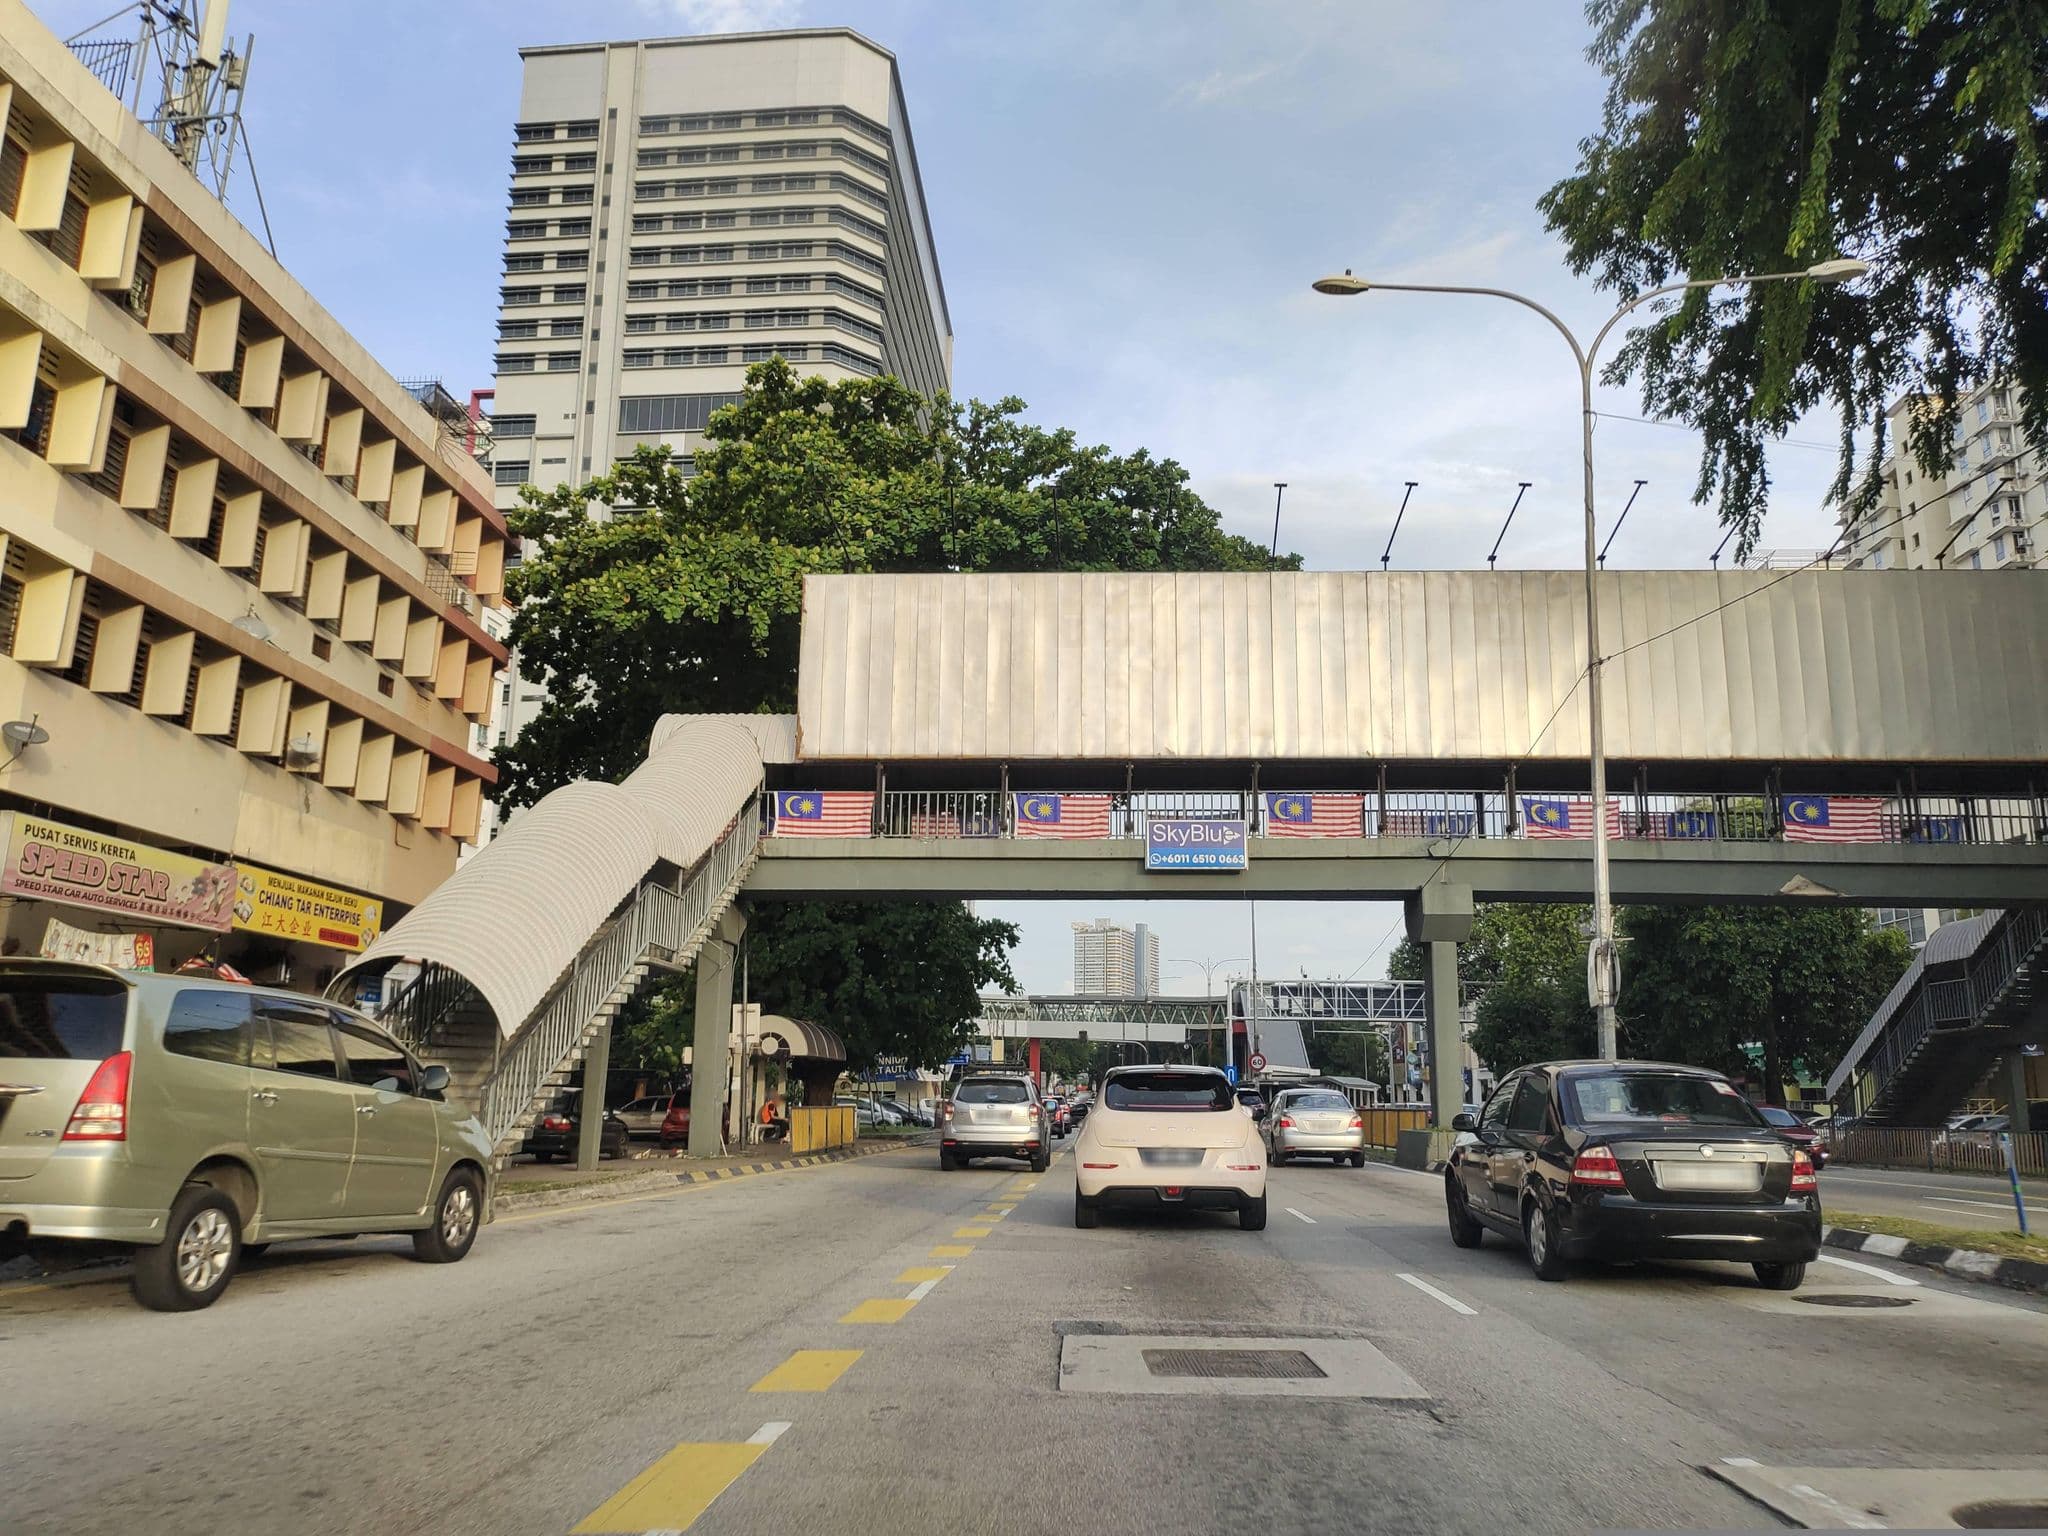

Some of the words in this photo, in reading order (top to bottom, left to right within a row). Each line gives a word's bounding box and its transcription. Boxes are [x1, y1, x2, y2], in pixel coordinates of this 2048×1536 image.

[24, 824, 60, 843] PUSAT
[63, 833, 98, 852] SERVIS
[100, 842, 136, 861] KERETA
[20, 841, 107, 888] SPEED
[107, 861, 170, 902] STAR
[1161, 854, 1190, 864] +6011
[1192, 854, 1216, 864] 6510
[1218, 854, 1245, 864] 0663
[14, 878, 41, 891] SPEED
[41, 884, 63, 897] STAR
[64, 888, 81, 898] CAR
[81, 892, 104, 903] AUTO
[104, 896, 138, 910] SERVICES
[267, 876, 295, 893] MENJUAL
[258, 889, 293, 910] CHIANG
[295, 898, 312, 916] TAR
[261, 911, 312, 937] 江大企业
